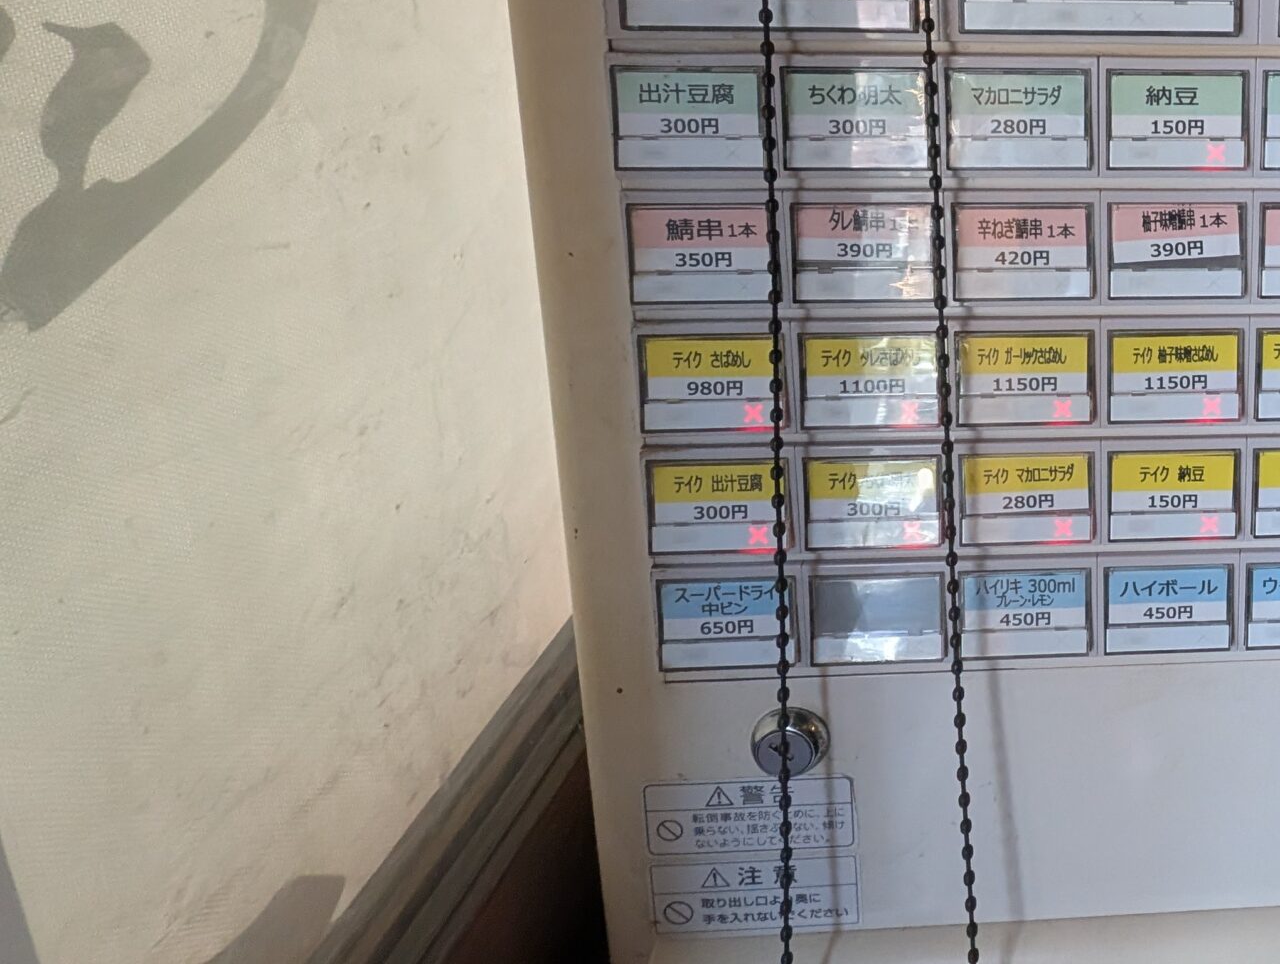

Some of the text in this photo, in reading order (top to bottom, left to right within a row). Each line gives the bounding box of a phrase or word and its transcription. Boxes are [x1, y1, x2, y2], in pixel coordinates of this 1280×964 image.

[639, 82, 735, 106] 出汁豆腐
[971, 84, 1063, 107] マカロニサラダ
[1145, 85, 1200, 107] 納豆
[660, 117, 720, 135] 300円
[828, 118, 887, 136] 300円
[990, 118, 1047, 136] 280円
[1151, 119, 1205, 136] 150円
[1200, 211, 1229, 229] 1本
[728, 222, 758, 239] 1本
[1047, 222, 1076, 239] 1本
[837, 242, 893, 259] 390円
[994, 249, 1051, 267] 420円
[1150, 239, 1205, 259] 390円
[675, 250, 732, 269] 350円
[672, 348, 752, 370] テイク さばめし
[820, 348, 852, 369] テイク
[977, 347, 1000, 366] テイク
[1132, 347, 1153, 365] テイク
[687, 380, 744, 397] 980円
[839, 378, 906, 395] 1100円
[993, 376, 1058, 393] 1150円
[1144, 374, 1209, 391] 1150円
[828, 471, 857, 491] テイク
[983, 463, 1075, 485] テイク マカロニサラダ
[1139, 464, 1206, 483] テイク 納豆
[673, 473, 763, 494] テイク 出汁豆腐
[847, 501, 901, 517] 300円
[1002, 493, 1055, 510] 280円
[1149, 494, 1198, 509] 150円
[693, 504, 748, 520] 300円
[674, 582, 777, 604] スーパードライ
[976, 577, 1076, 595] ハイリキ 300ml
[1119, 578, 1219, 598] ハイボール
[702, 602, 749, 617] 中ビン
[1143, 605, 1193, 621] 450円
[700, 619, 754, 635] 650円
[1000, 611, 1051, 627] 450円
[701, 893, 821, 909] 取り出し口よ奥に
